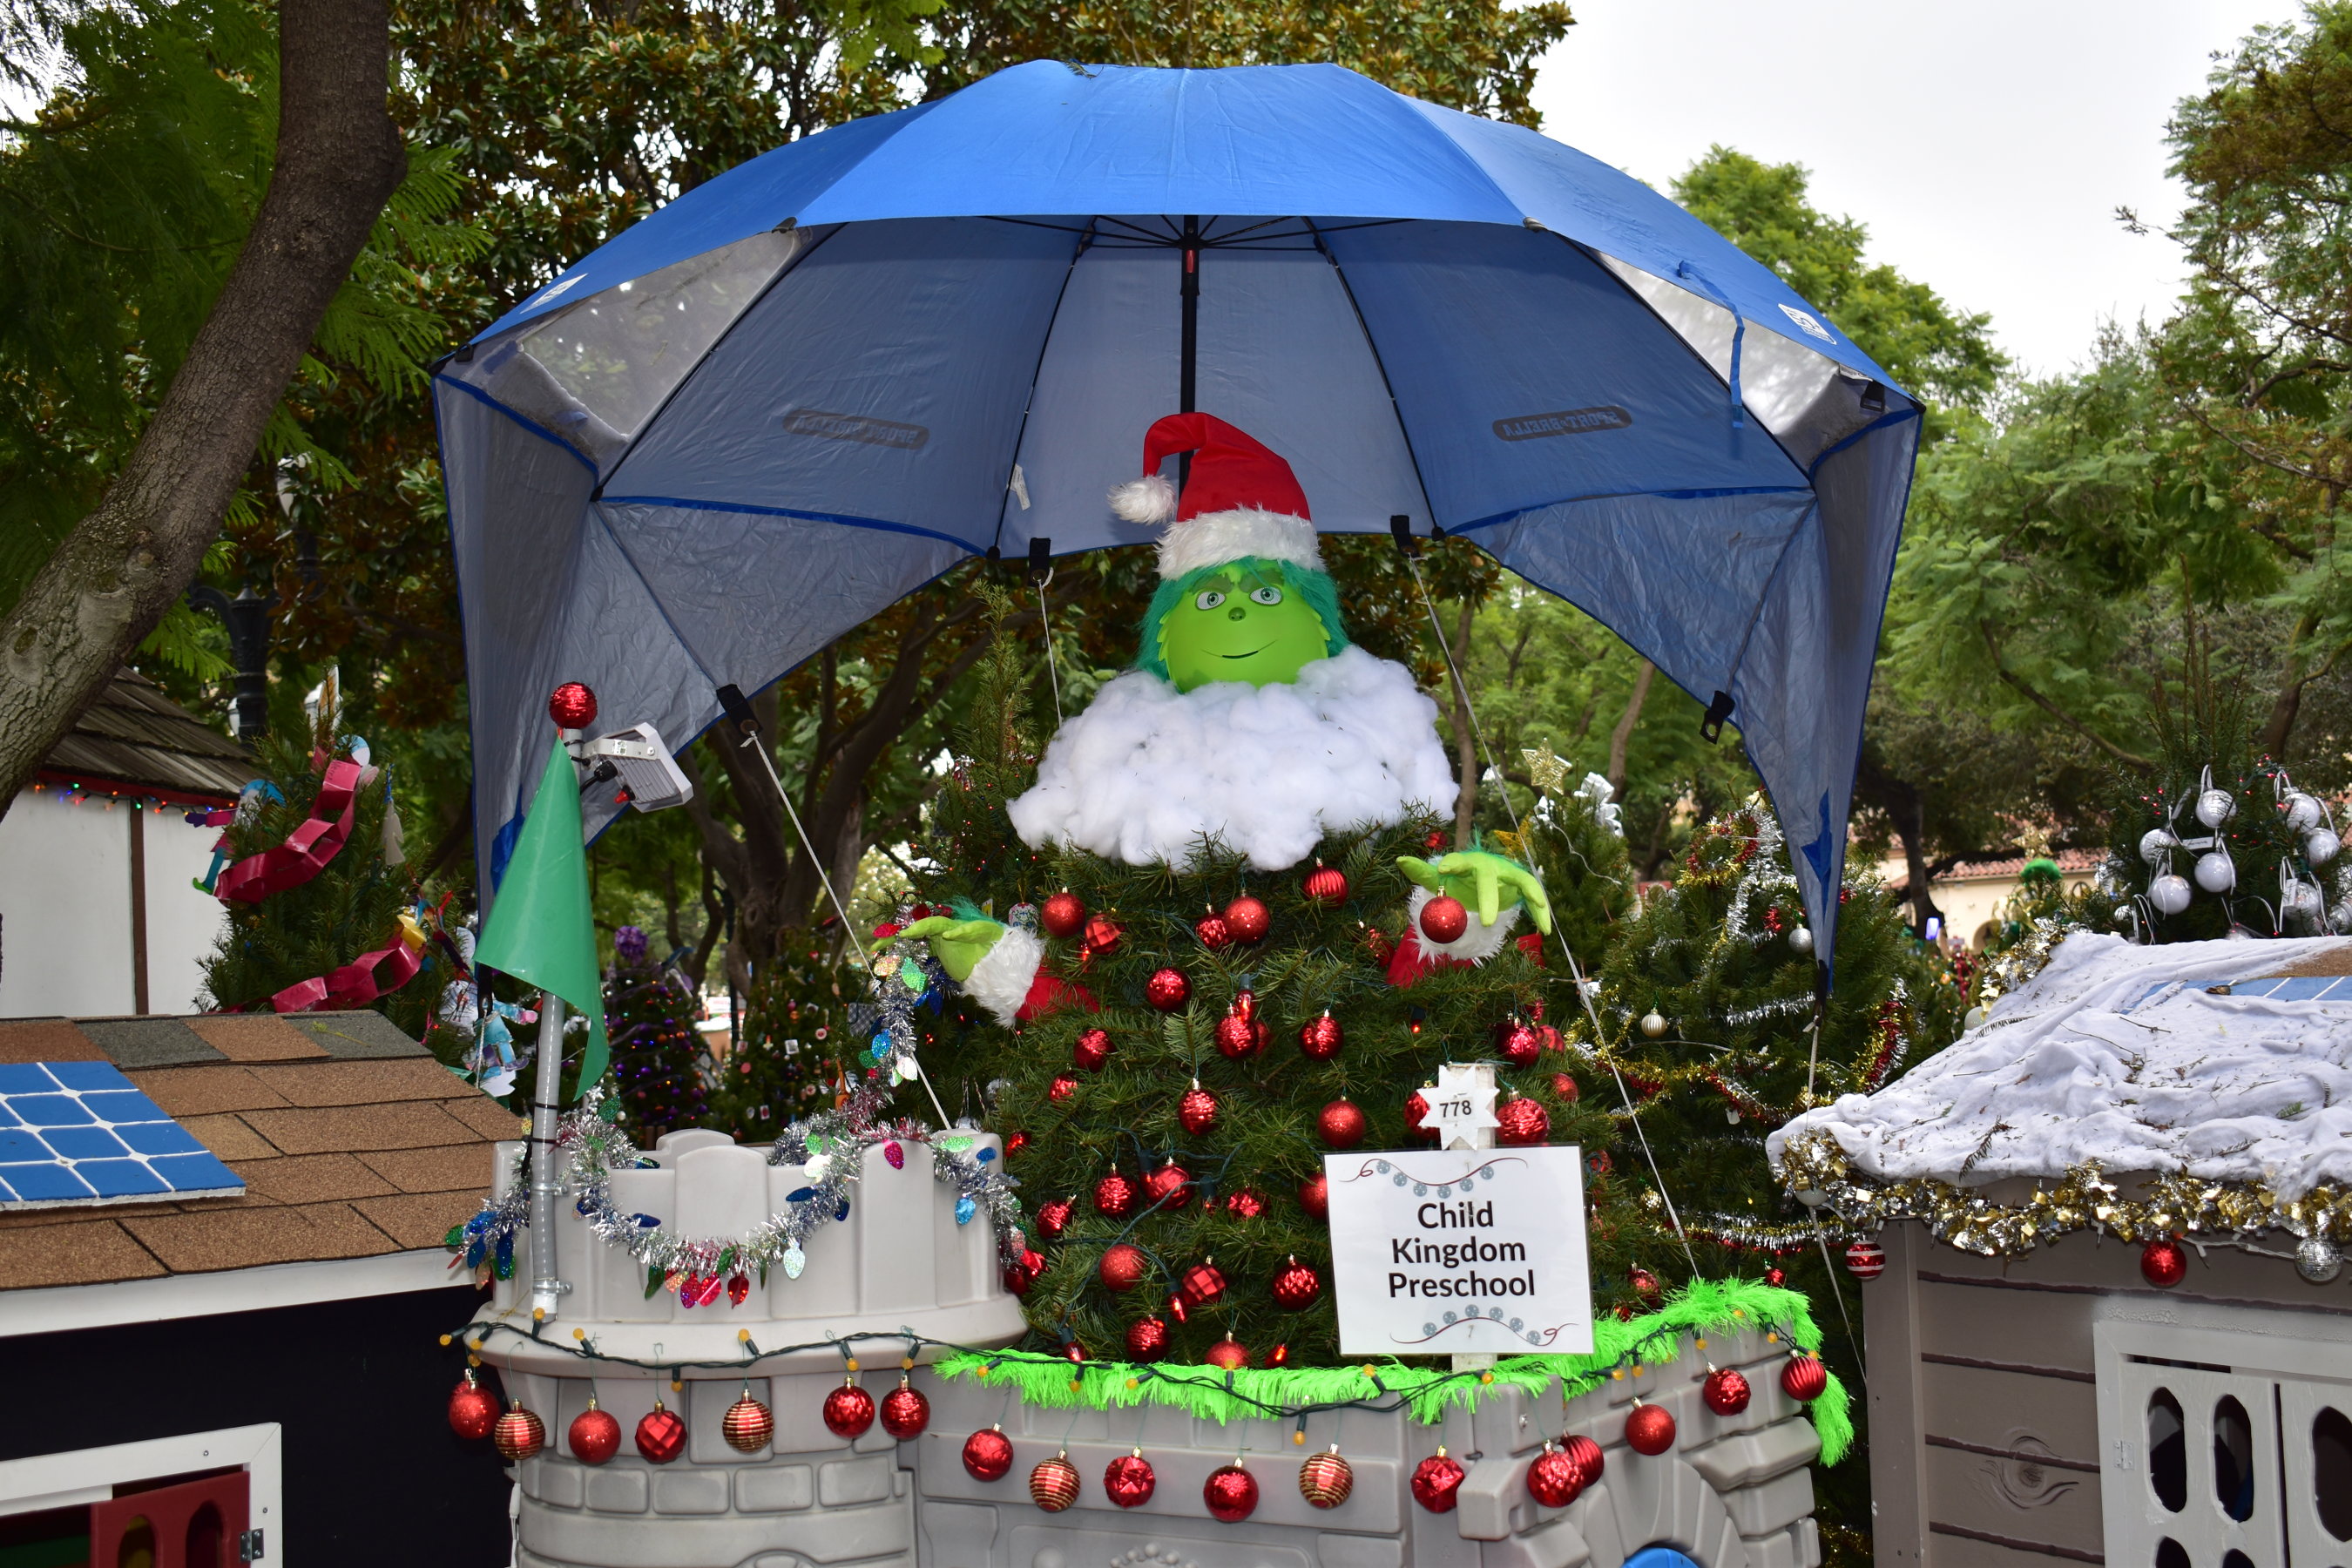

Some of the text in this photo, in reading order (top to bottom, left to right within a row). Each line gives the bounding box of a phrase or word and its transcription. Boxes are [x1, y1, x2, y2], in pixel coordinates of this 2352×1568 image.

[1439, 1100, 1472, 1118] 778
[1417, 1200, 1494, 1228] Child
[1392, 1236, 1526, 1268] Kingdom
[1389, 1269, 1536, 1298] Preschool
